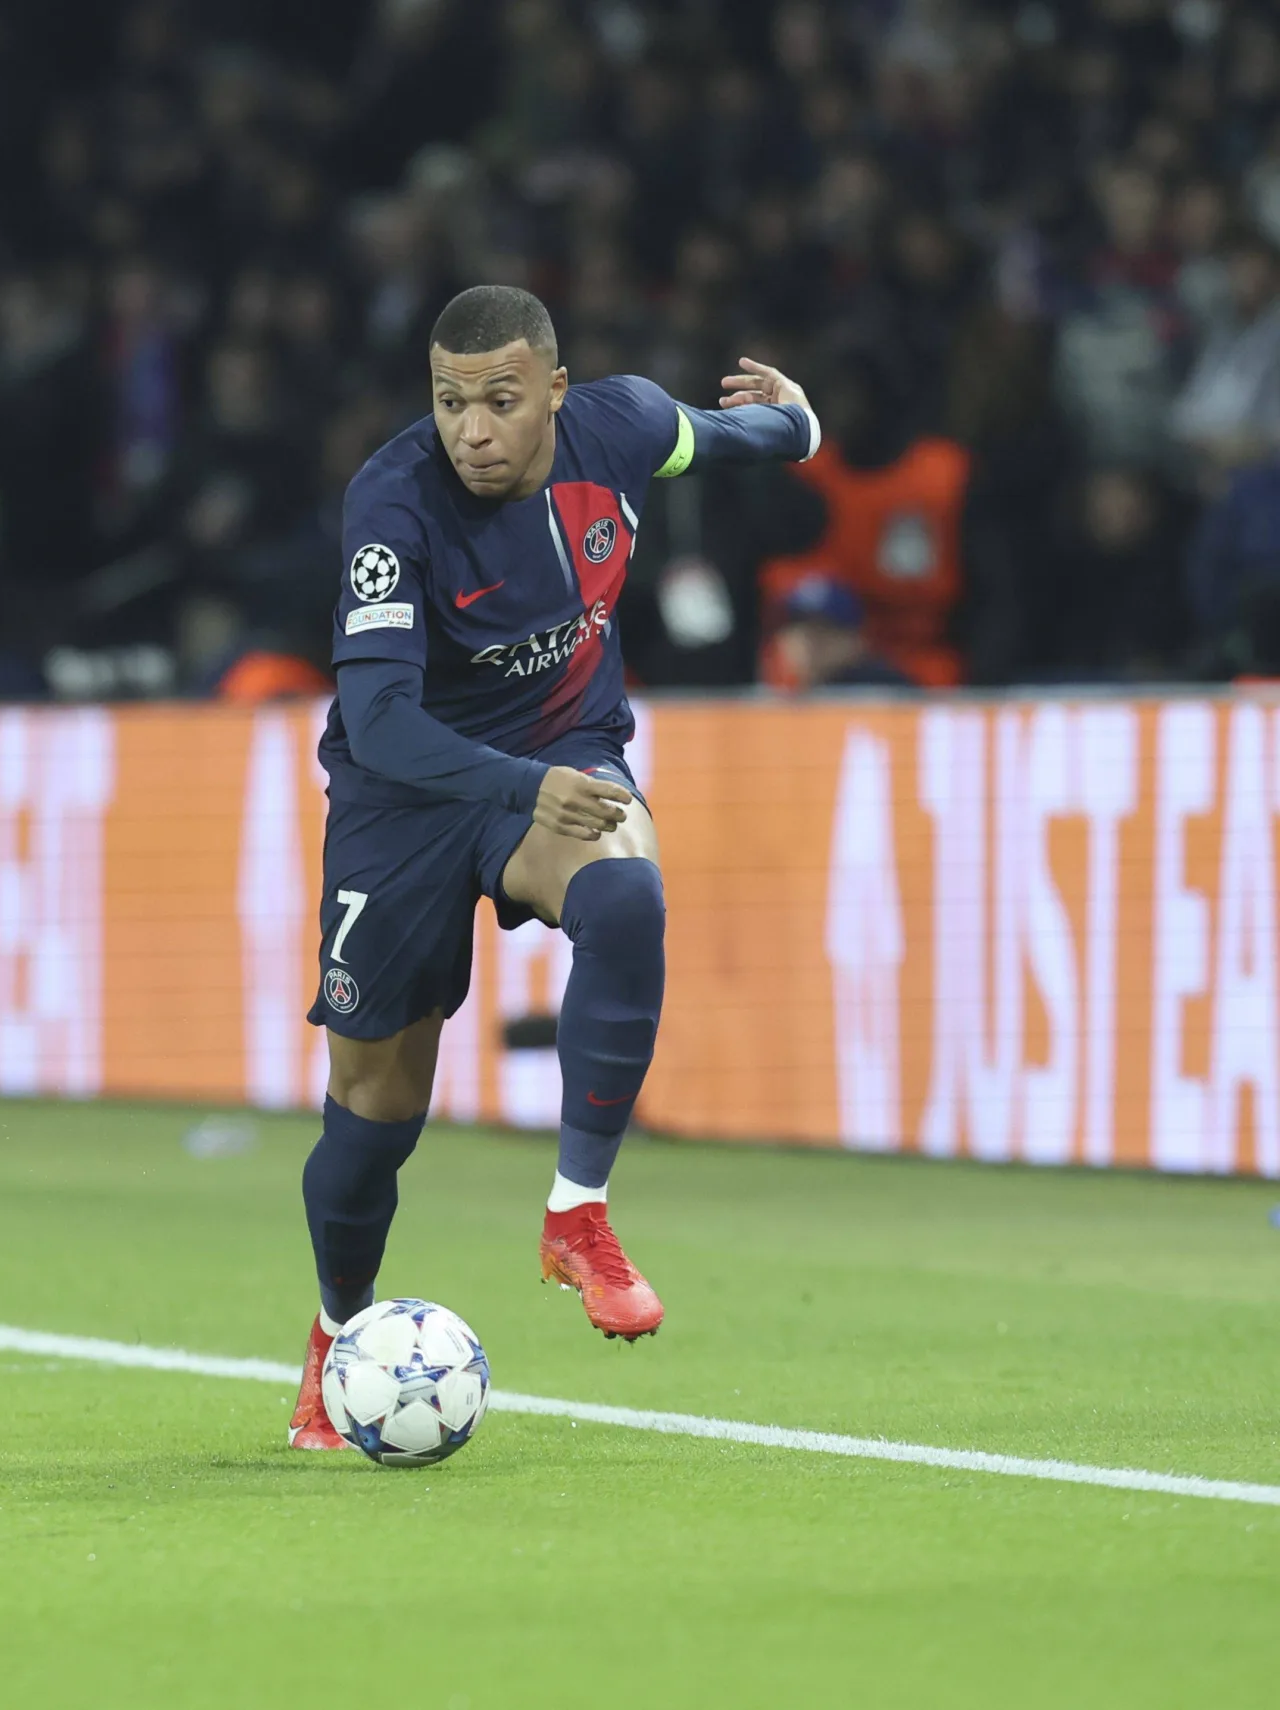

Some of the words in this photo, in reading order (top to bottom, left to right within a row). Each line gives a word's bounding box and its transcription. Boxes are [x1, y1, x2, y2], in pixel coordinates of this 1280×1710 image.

[586, 520, 609, 539] PARIS
[347, 610, 412, 626] FOUNDATION
[330, 890, 368, 964] 7
[1150, 702, 1280, 1179] EA
[328, 970, 351, 985] PARIS
